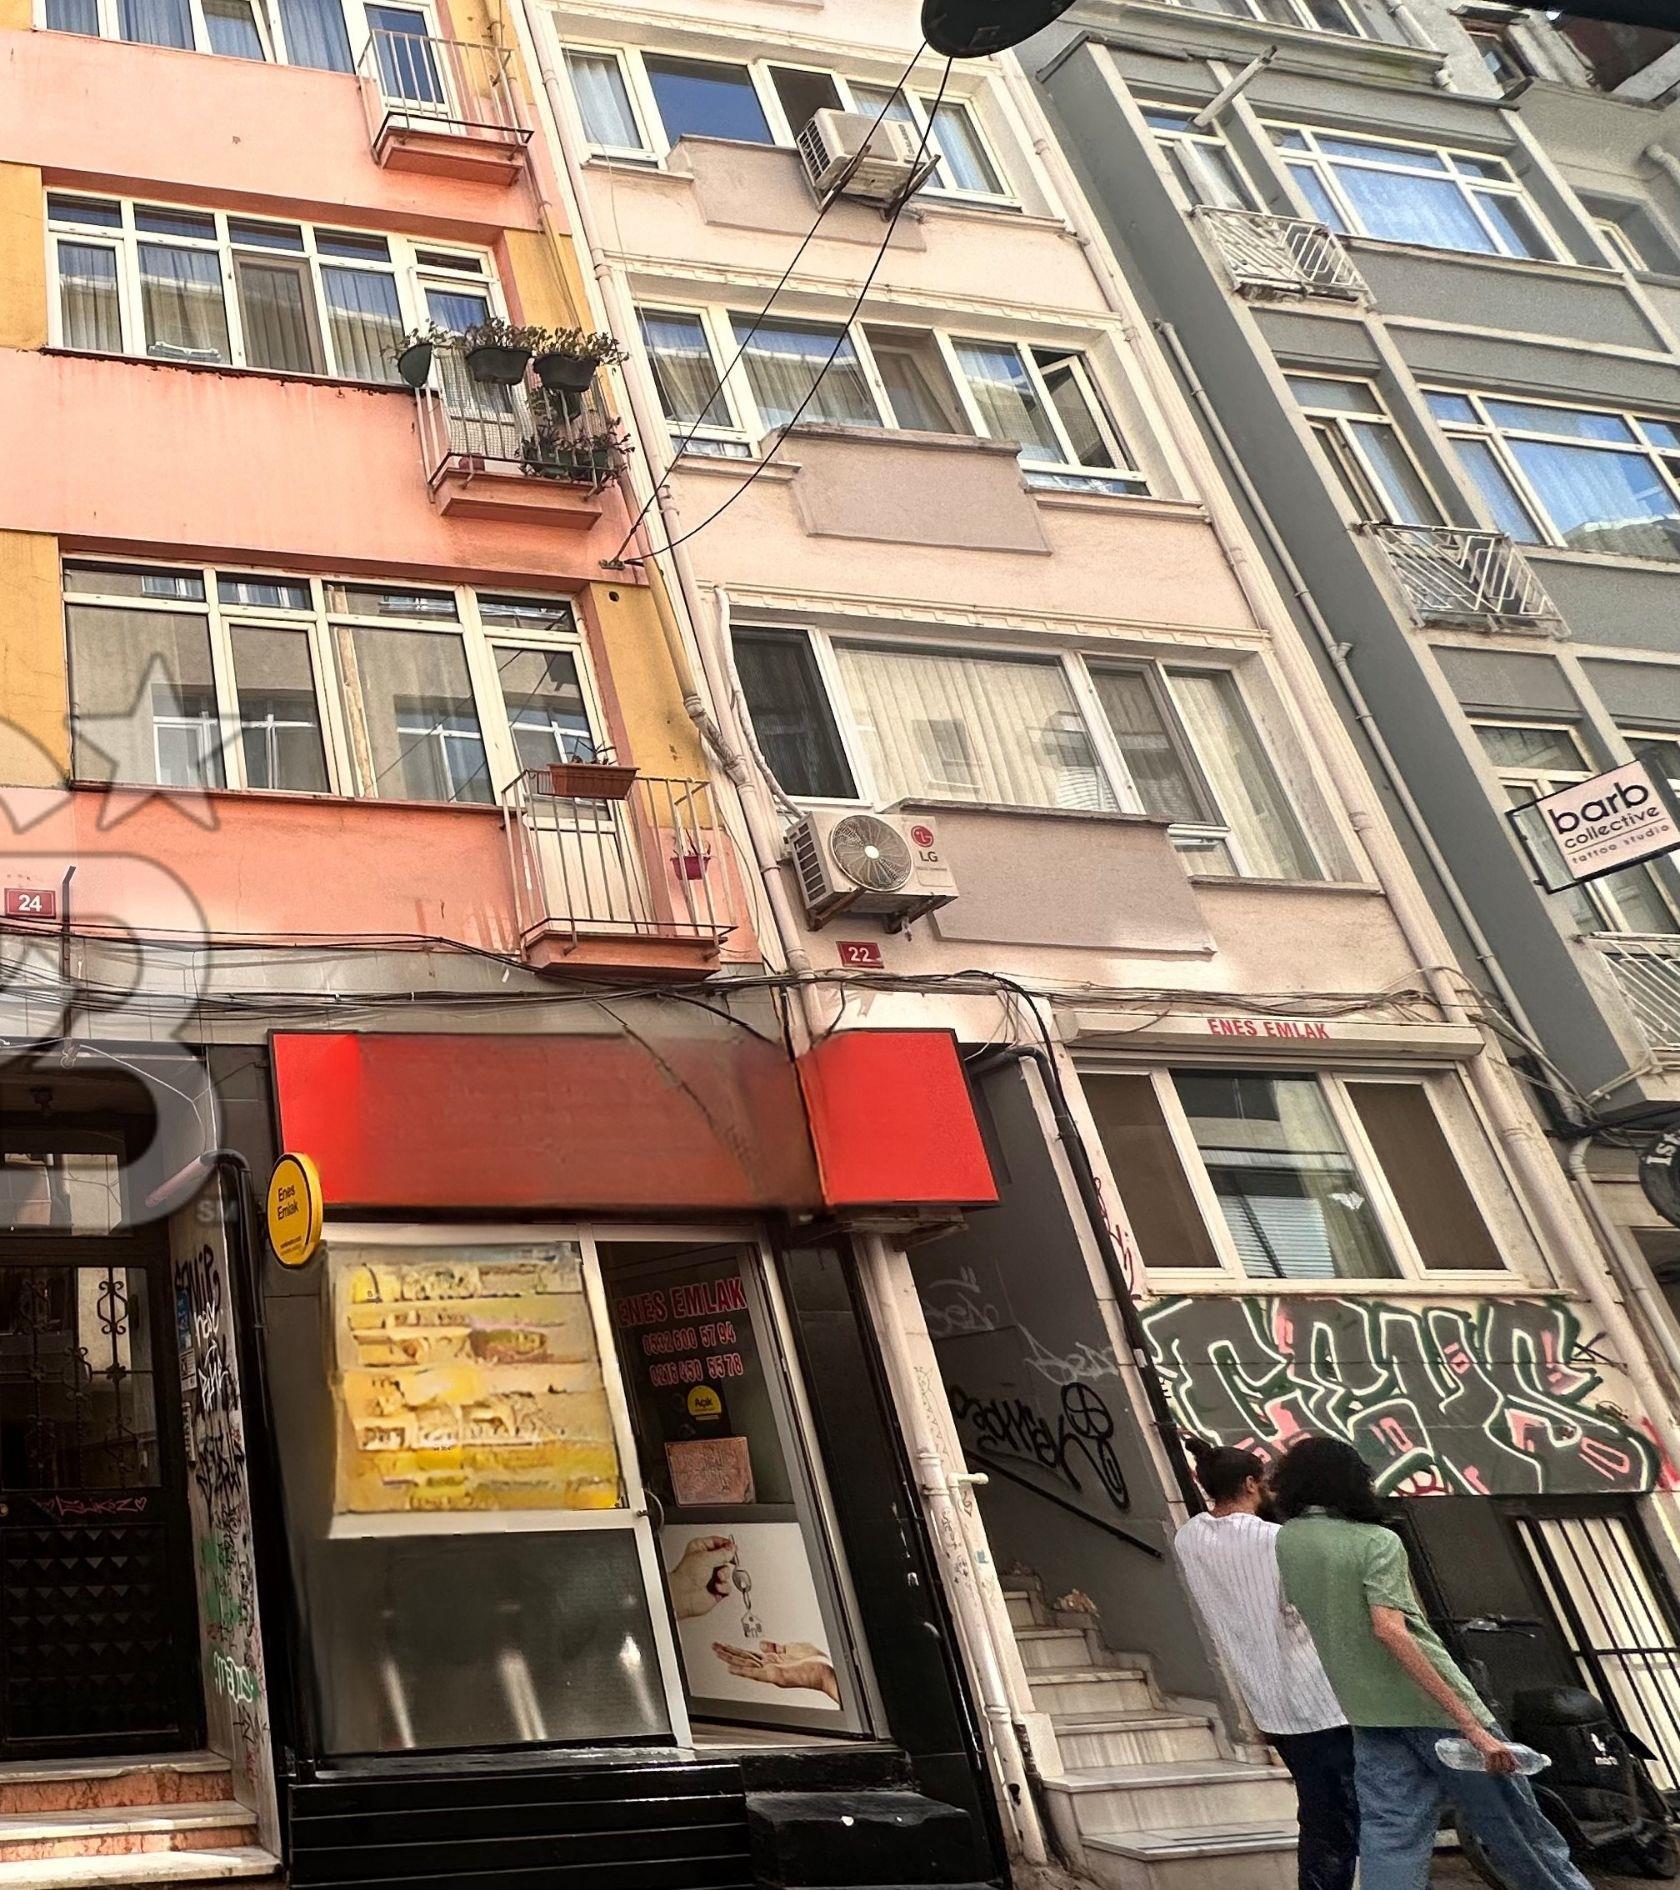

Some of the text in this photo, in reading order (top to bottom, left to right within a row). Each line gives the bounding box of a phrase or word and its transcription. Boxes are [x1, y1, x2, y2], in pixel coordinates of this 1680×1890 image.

[1548, 782, 1649, 835] barb
[1564, 806, 1660, 848] collective
[1572, 824, 1669, 864] tattoo studio
[919, 851, 938, 862] LG
[19, 894, 42, 911] 24
[848, 946, 871, 962] 22
[1207, 1018, 1330, 1040] ENES EMLAK
[278, 1185, 295, 1202] Enes
[277, 1201, 299, 1220] Emlak
[620, 1277, 747, 1326] ENES EMLAK
